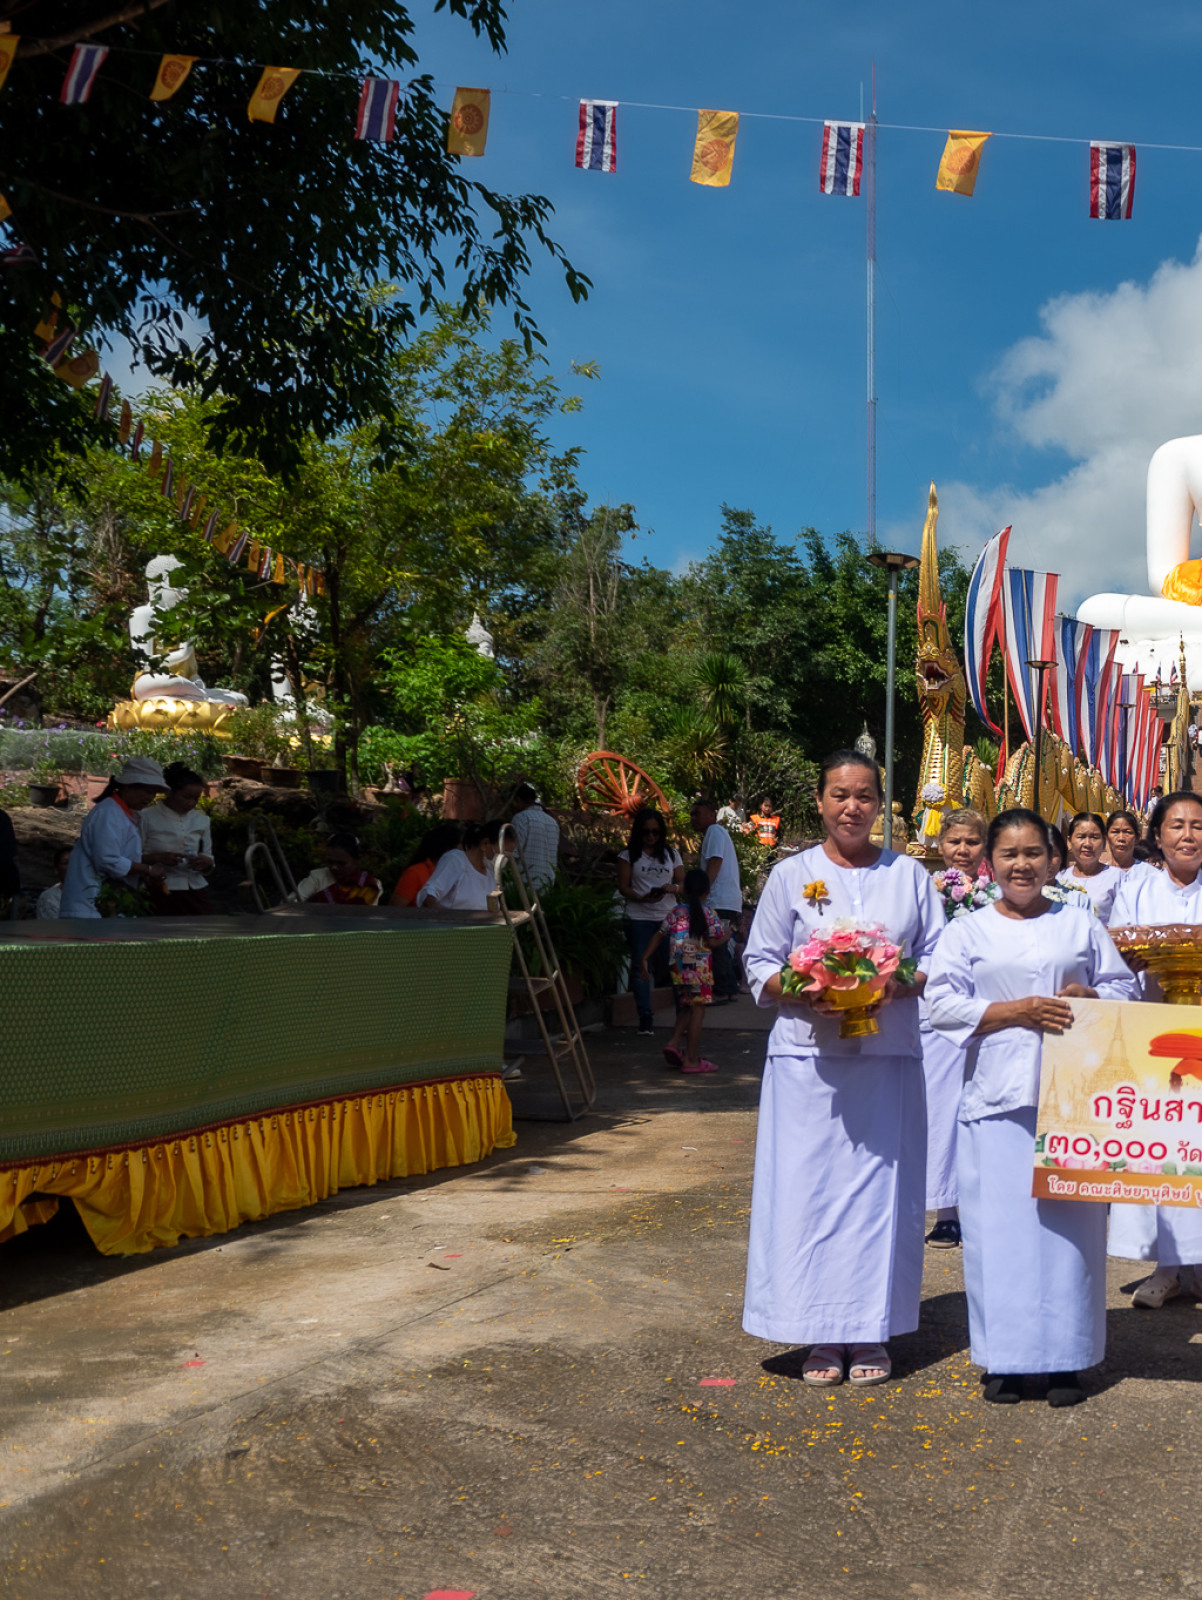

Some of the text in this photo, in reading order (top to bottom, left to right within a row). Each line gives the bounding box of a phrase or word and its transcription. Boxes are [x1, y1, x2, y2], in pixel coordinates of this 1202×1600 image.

[1048, 1134, 1168, 1162] ๓๐,๐๐๐
[1176, 1140, 1202, 1163] วัด
[1048, 1175, 1076, 1194] โดย
[1079, 1180, 1191, 1202] คณะศิษยานุศิษย์
